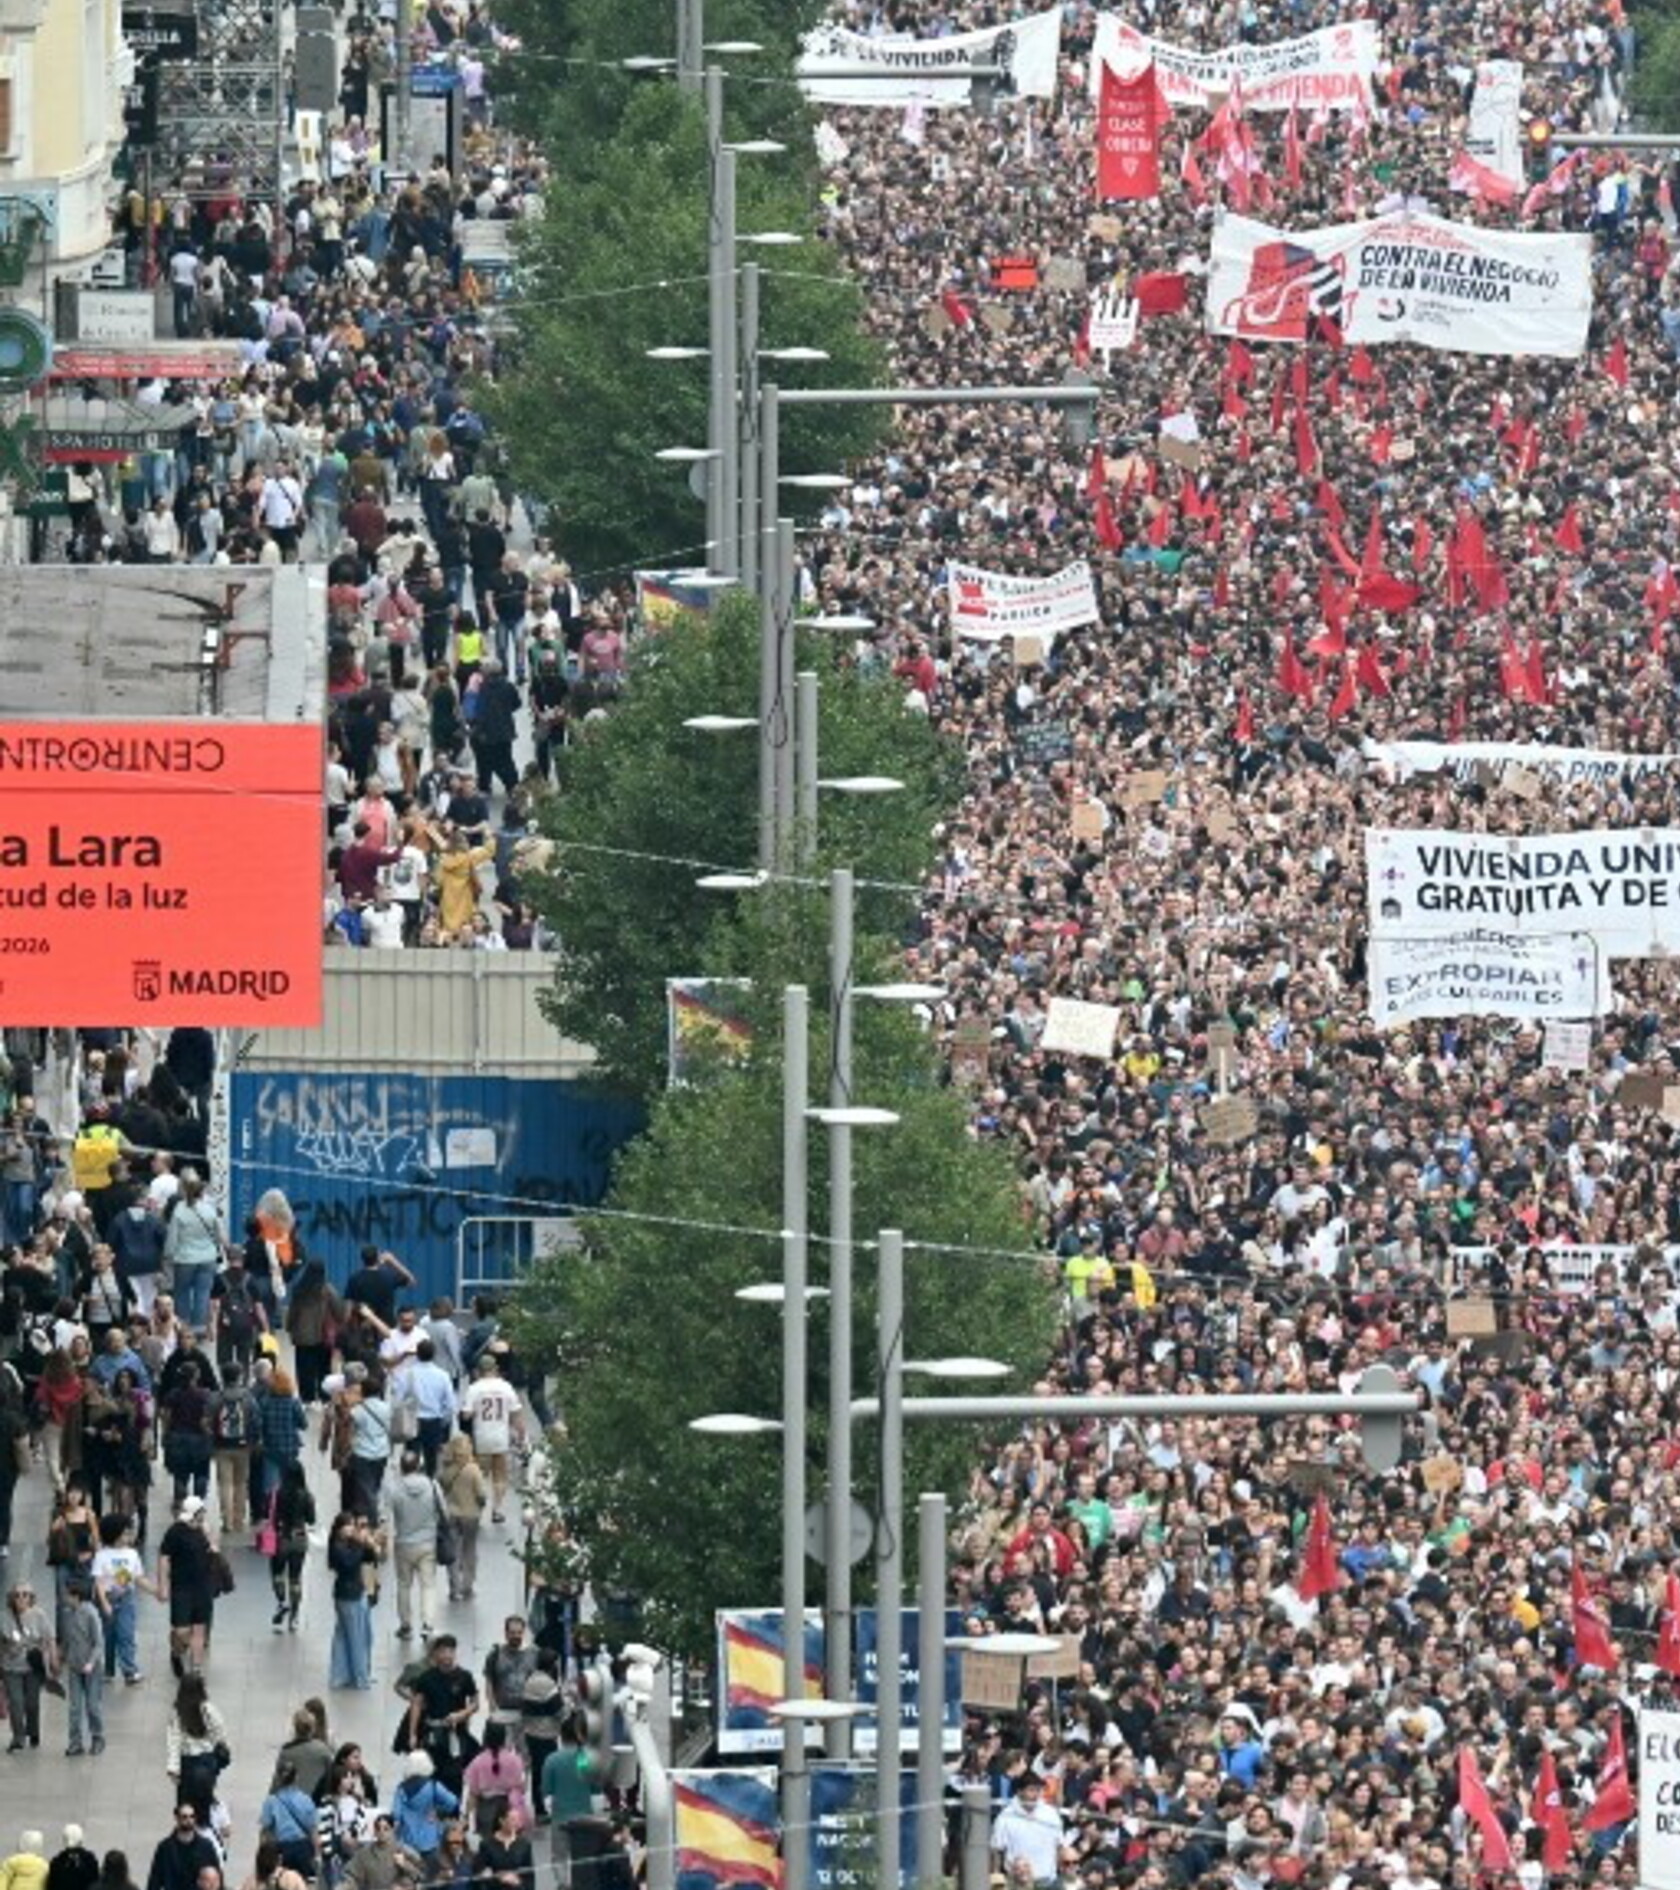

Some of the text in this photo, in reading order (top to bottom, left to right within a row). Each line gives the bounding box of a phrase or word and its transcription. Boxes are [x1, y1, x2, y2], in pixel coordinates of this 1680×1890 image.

[1361, 245, 1442, 272] CONTRA
[1444, 252, 1466, 276] EL
[1359, 269, 1511, 303] DE LA VIVIENDA
[49, 825, 162, 867] Lara
[1417, 846, 1591, 879] VIVIENDA
[57, 883, 96, 909] de
[106, 883, 132, 909] la
[143, 883, 188, 909] luz
[1417, 883, 1581, 915] GRATUITA
[1591, 880, 1613, 906] Y
[1623, 880, 1668, 906] DE
[0, 938, 51, 953] 2026
[169, 970, 290, 1001] MADRID
[1385, 963, 1563, 994] EXPROPIAR
[482, 1397, 503, 1421] 21
[1646, 1733, 1669, 1763] El
